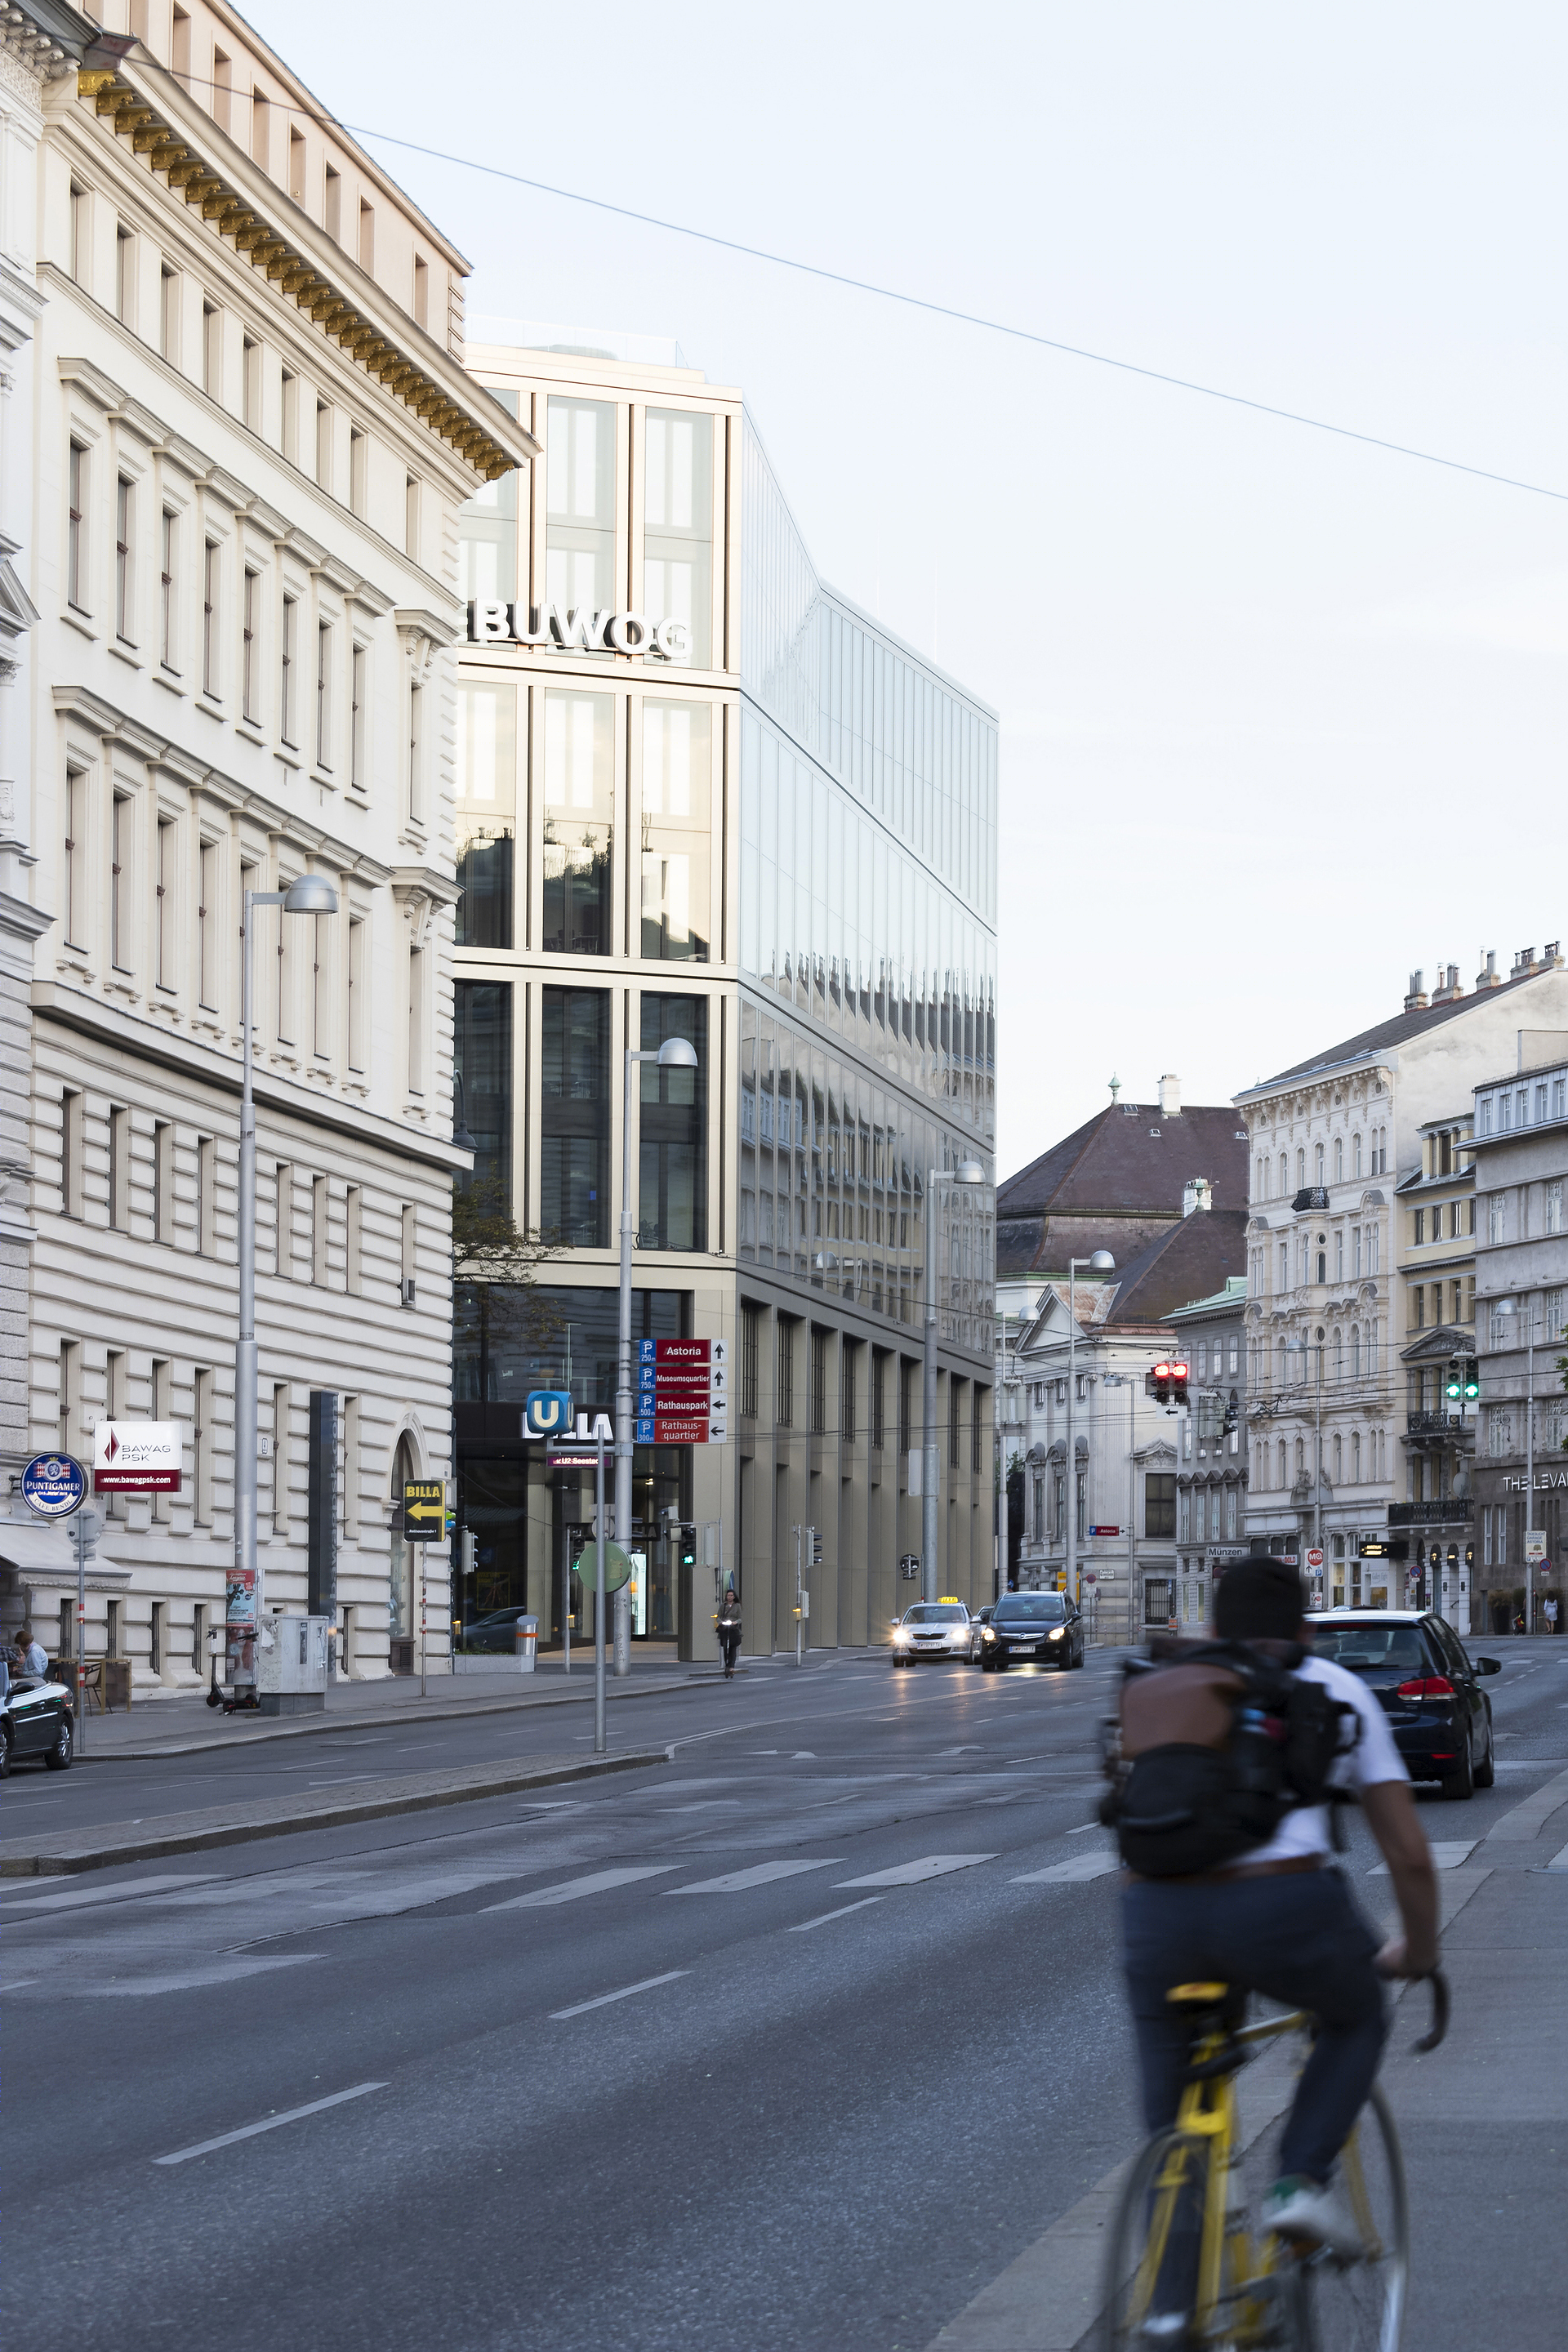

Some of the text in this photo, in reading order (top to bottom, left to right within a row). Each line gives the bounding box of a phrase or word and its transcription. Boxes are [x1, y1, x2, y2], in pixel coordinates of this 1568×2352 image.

[474, 597, 693, 658] BUWOG
[667, 1347, 702, 1355] Astoria
[657, 1374, 710, 1383] Museumsquartier
[658, 1401, 708, 1410] Rathauspark
[534, 1400, 559, 1428] U
[662, 1421, 702, 1430] Rathaus-
[663, 1431, 700, 1440] quartier
[122, 1445, 171, 1453] BAWAG
[122, 1454, 150, 1462] PSK
[102, 1476, 171, 1485] www.bawagpsk.com
[1503, 1472, 1568, 1491] THE LEVA
[26, 1481, 80, 1491] PUNTIGAMER
[406, 1486, 440, 1498] BILLA
[51, 1499, 73, 1512] BENDL
[1208, 1547, 1242, 1556] Münzen
[1309, 1552, 1322, 1561] MQ
